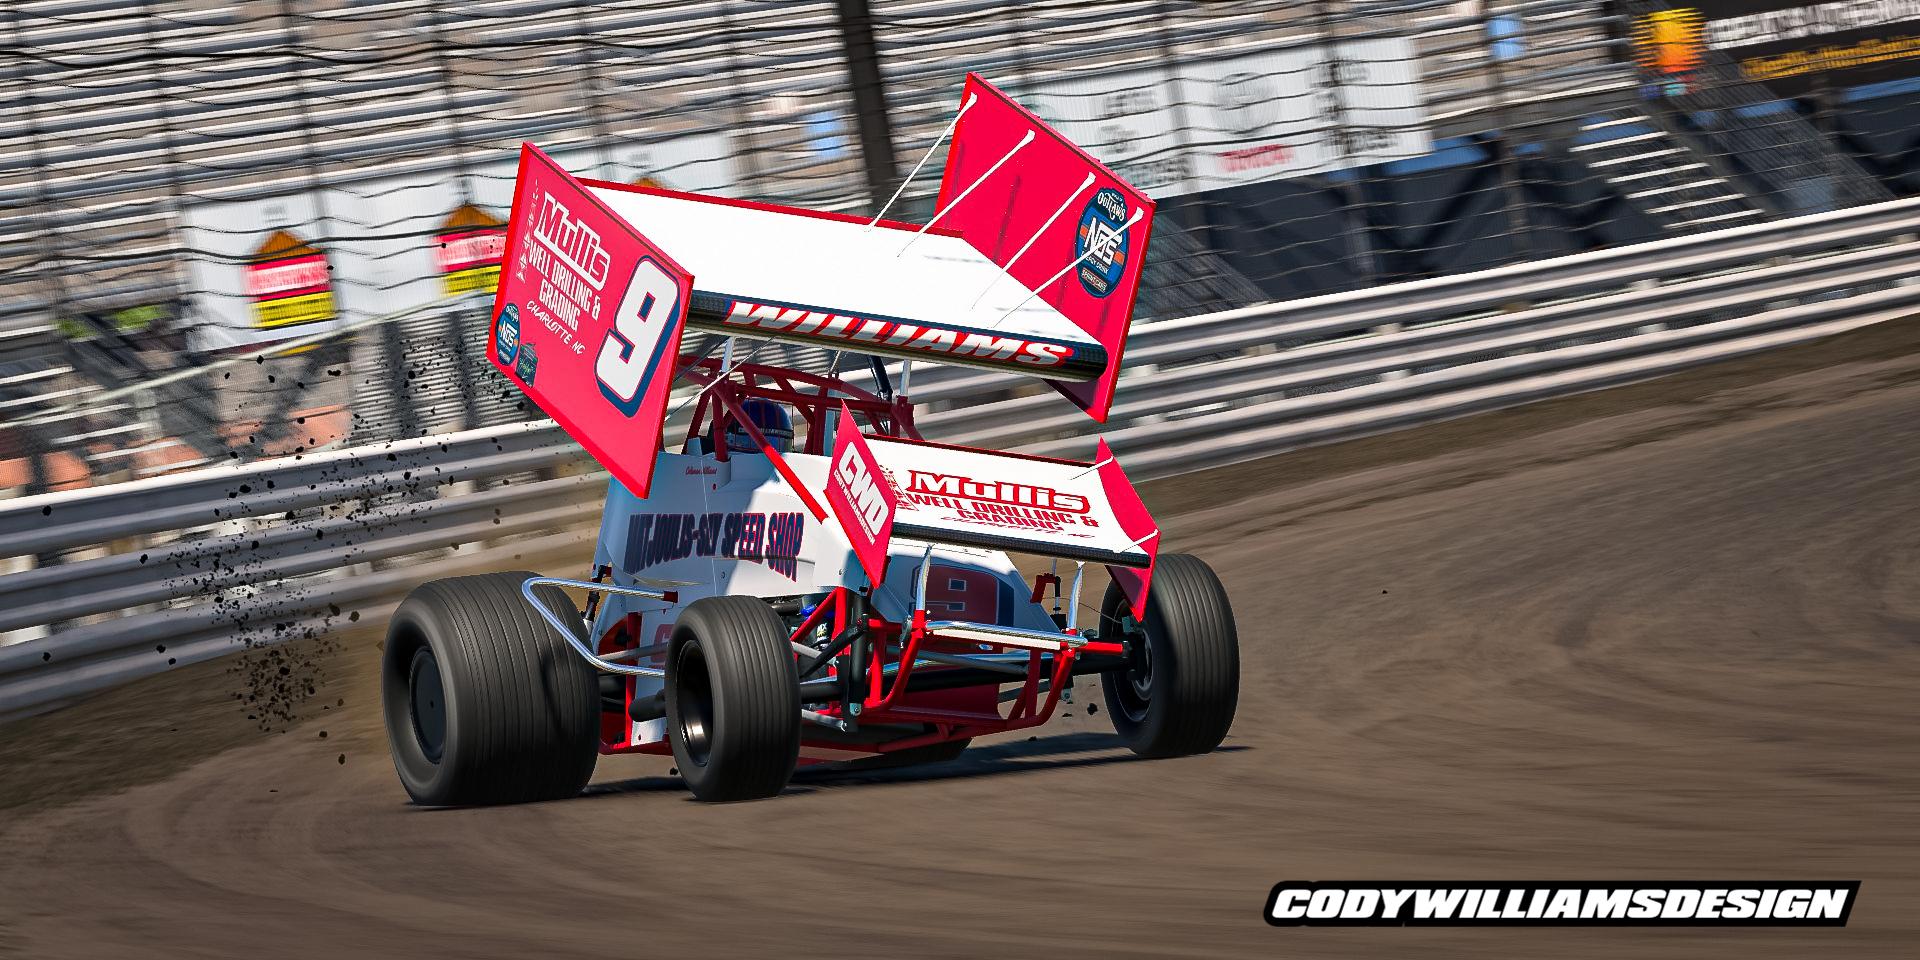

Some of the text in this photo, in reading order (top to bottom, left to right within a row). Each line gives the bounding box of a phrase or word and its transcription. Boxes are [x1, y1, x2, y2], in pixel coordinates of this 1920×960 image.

[534, 191, 610, 291] Mullis
[529, 239, 551, 278] WELL
[551, 259, 593, 313] DRILLING
[592, 294, 601, 320] &
[539, 278, 580, 332] GRADING
[571, 340, 586, 355] NC
[595, 255, 680, 417] 9
[724, 300, 1074, 367] WILLIAMS
[839, 441, 889, 536] CWD
[905, 470, 1091, 514] Mullis
[905, 492, 968, 511] WELL
[971, 501, 1076, 524] DRILLING
[1080, 515, 1100, 528] &
[957, 509, 1065, 531] GRADING
[721, 511, 767, 565] SPEED
[765, 511, 805, 583] SHOP
